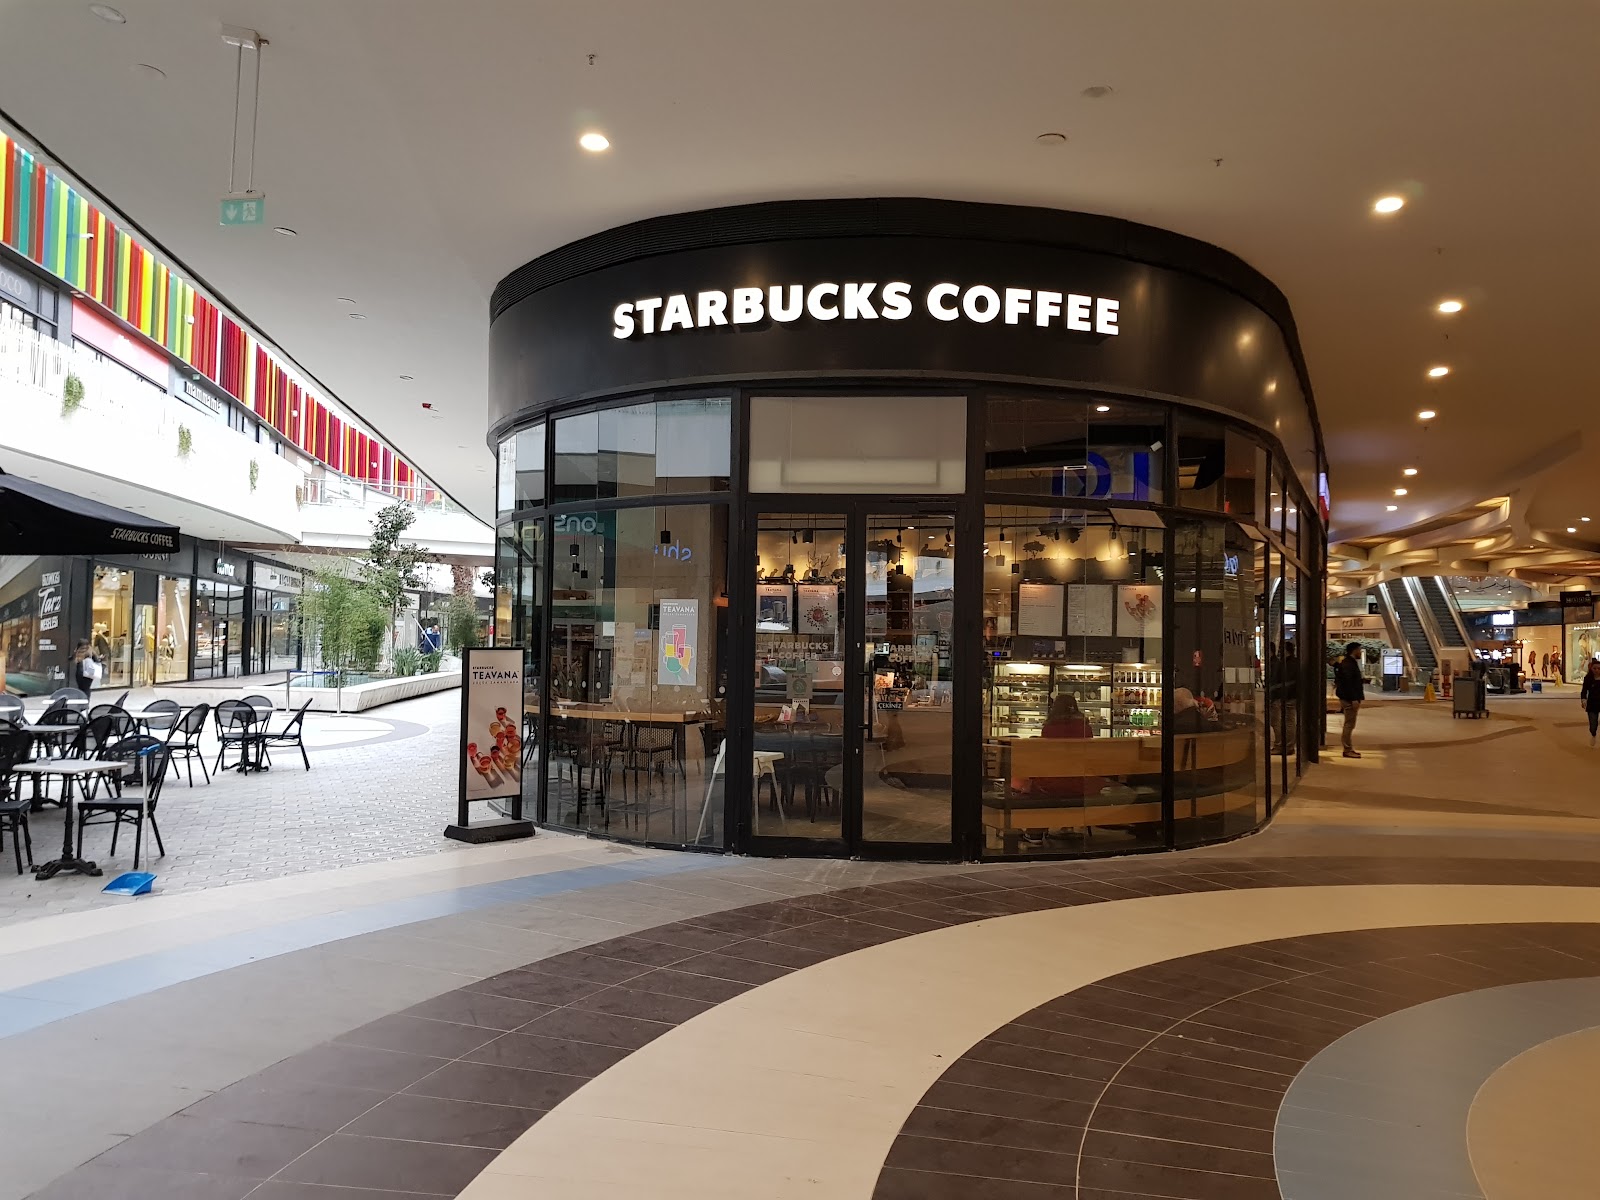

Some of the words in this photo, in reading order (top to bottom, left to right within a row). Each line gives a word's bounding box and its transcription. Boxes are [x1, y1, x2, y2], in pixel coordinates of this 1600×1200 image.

[613, 281, 912, 340] STARBUCKS
[926, 282, 1120, 336] COFFEE
[110, 527, 150, 544] STARBUCKS
[150, 533, 174, 548] COFFEE
[662, 605, 696, 613] TEAVANA
[767, 641, 829, 650] STARBUCKS
[876, 644, 940, 653] TARBS
[472, 670, 519, 680] TEAVANA
[878, 701, 902, 709] ÇEKİNİZ
